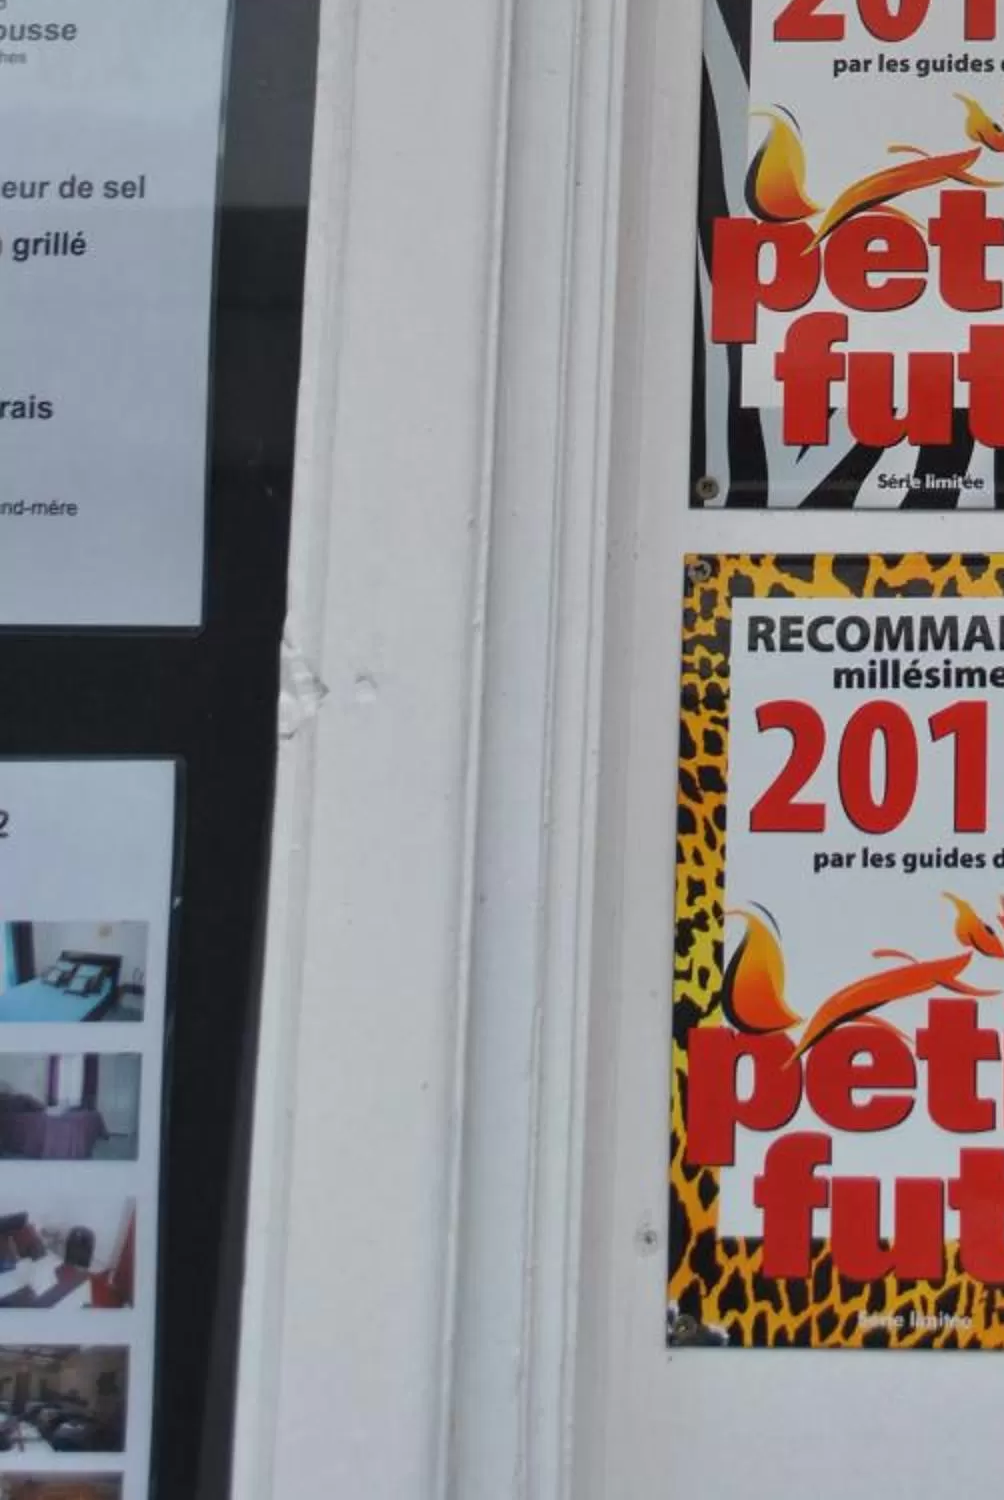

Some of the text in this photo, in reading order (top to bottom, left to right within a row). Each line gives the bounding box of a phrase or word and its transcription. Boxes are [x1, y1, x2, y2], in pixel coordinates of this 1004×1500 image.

[833, 55, 873, 78] par
[878, 53, 910, 73] les
[916, 53, 995, 78] guides
[1, 173, 147, 199] eur de sel
[12, 230, 88, 263] grillé
[877, 473, 985, 491] Série limitée
[814, 850, 855, 873] par
[861, 848, 896, 869] les
[902, 848, 986, 873] guides
